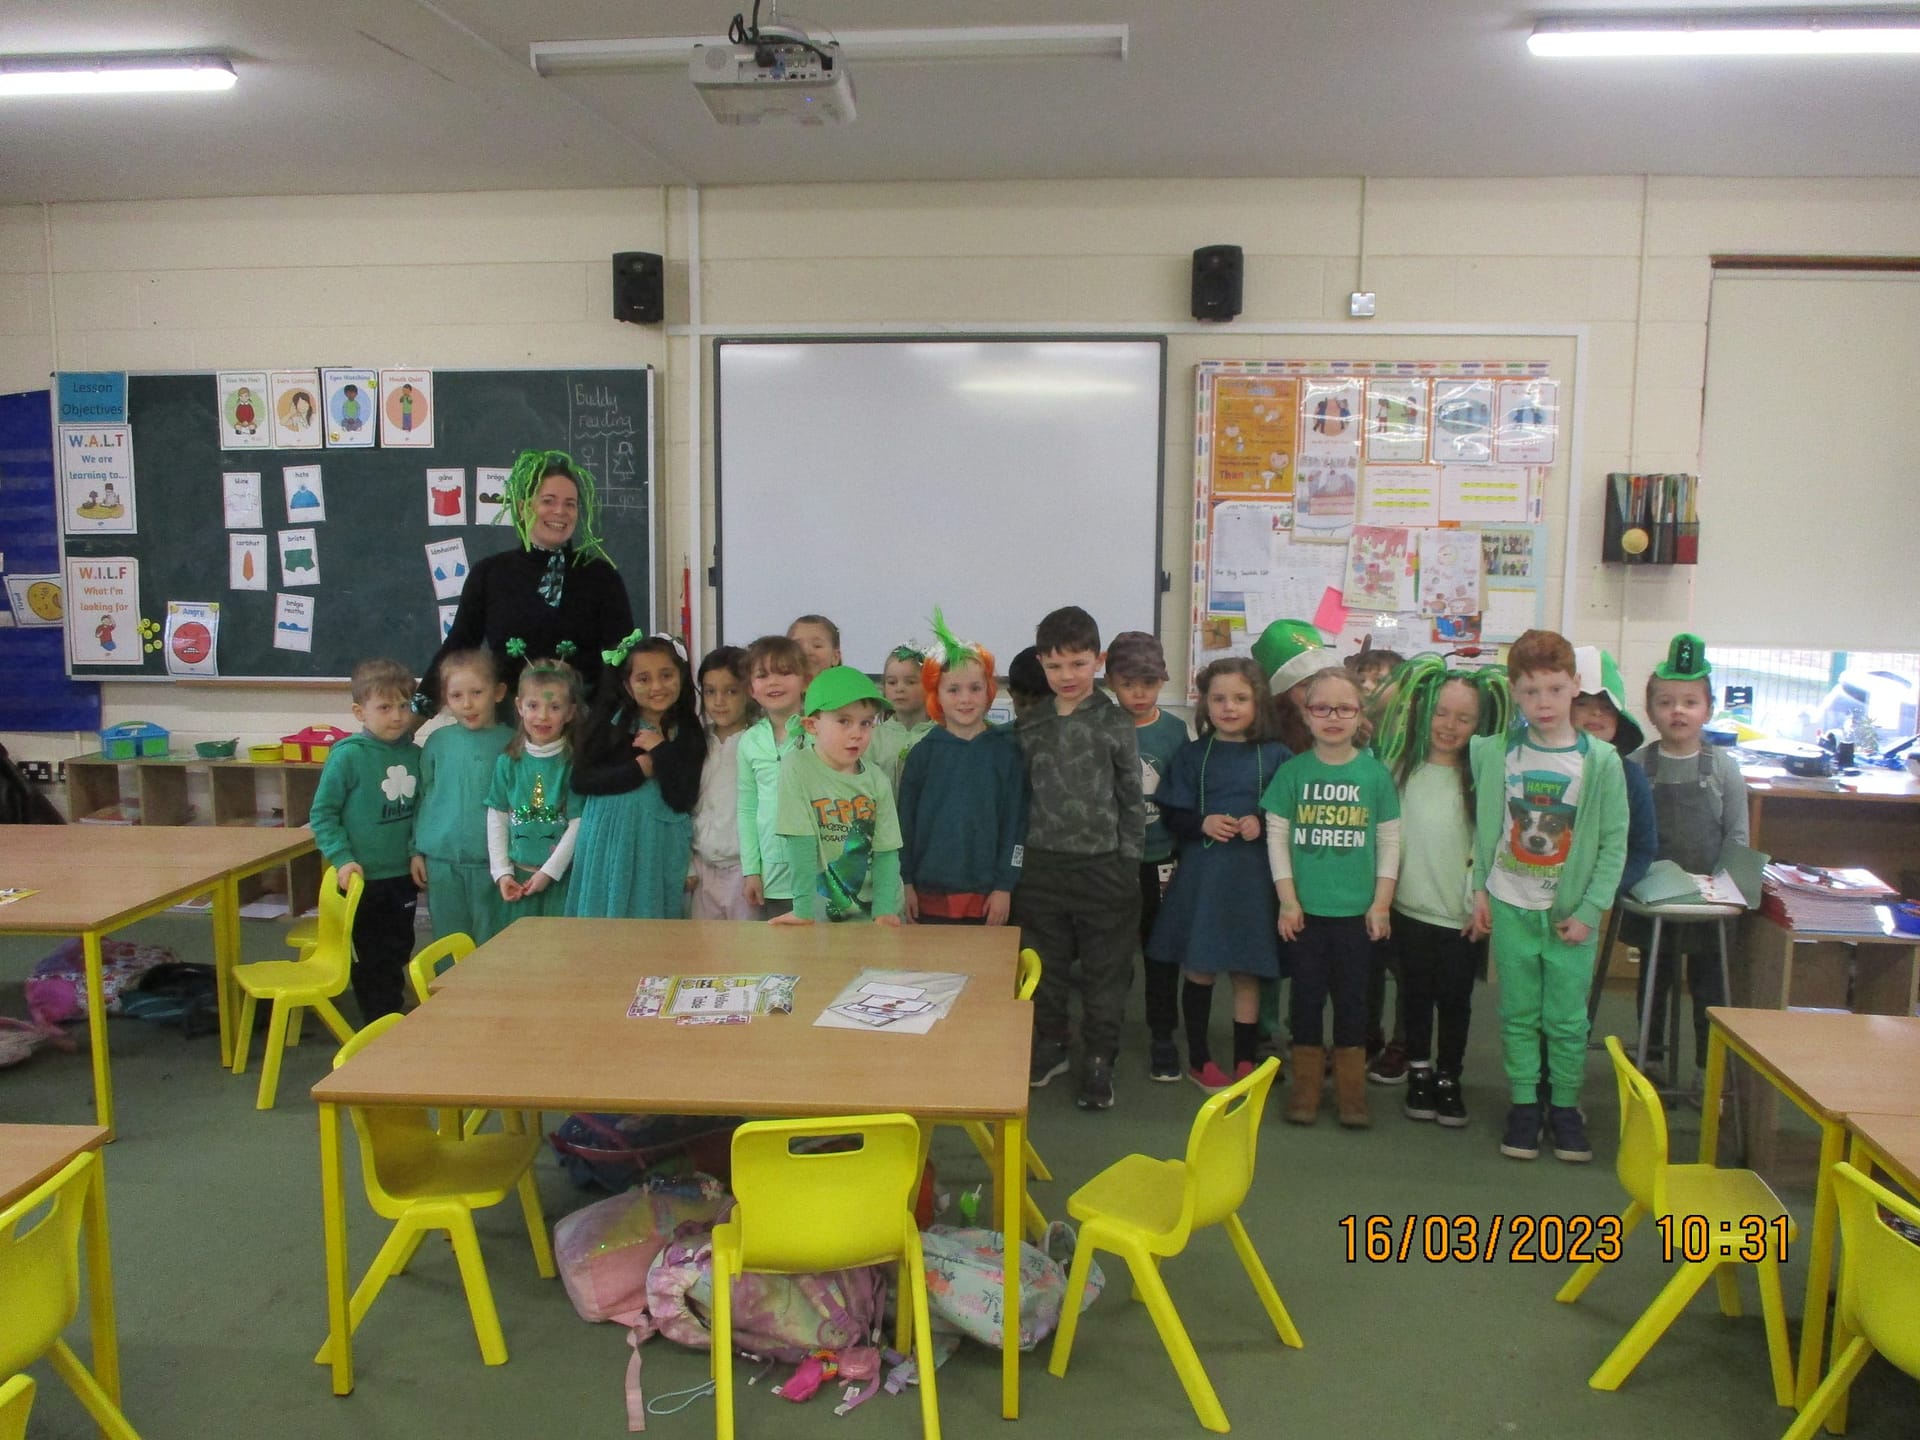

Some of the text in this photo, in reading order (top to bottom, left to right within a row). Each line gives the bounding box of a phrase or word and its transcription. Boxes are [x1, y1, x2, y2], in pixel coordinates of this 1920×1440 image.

[73, 383, 113, 393] Lesson
[575, 384, 618, 414] Buddy
[62, 404, 123, 417] Objectives
[69, 434, 124, 448] W.A.L.T
[81, 455, 96, 463] We
[69, 471, 107, 481] learning
[80, 567, 127, 579] W.I.L.F
[84, 587, 123, 595] What I'm
[80, 604, 129, 613] looking for
[183, 608, 205, 617] Angry
[1303, 783, 1360, 802] I LOOK
[1527, 782, 1562, 794] HAPPY
[1297, 804, 1369, 827] WESOME
[1311, 828, 1365, 847] GREEN
